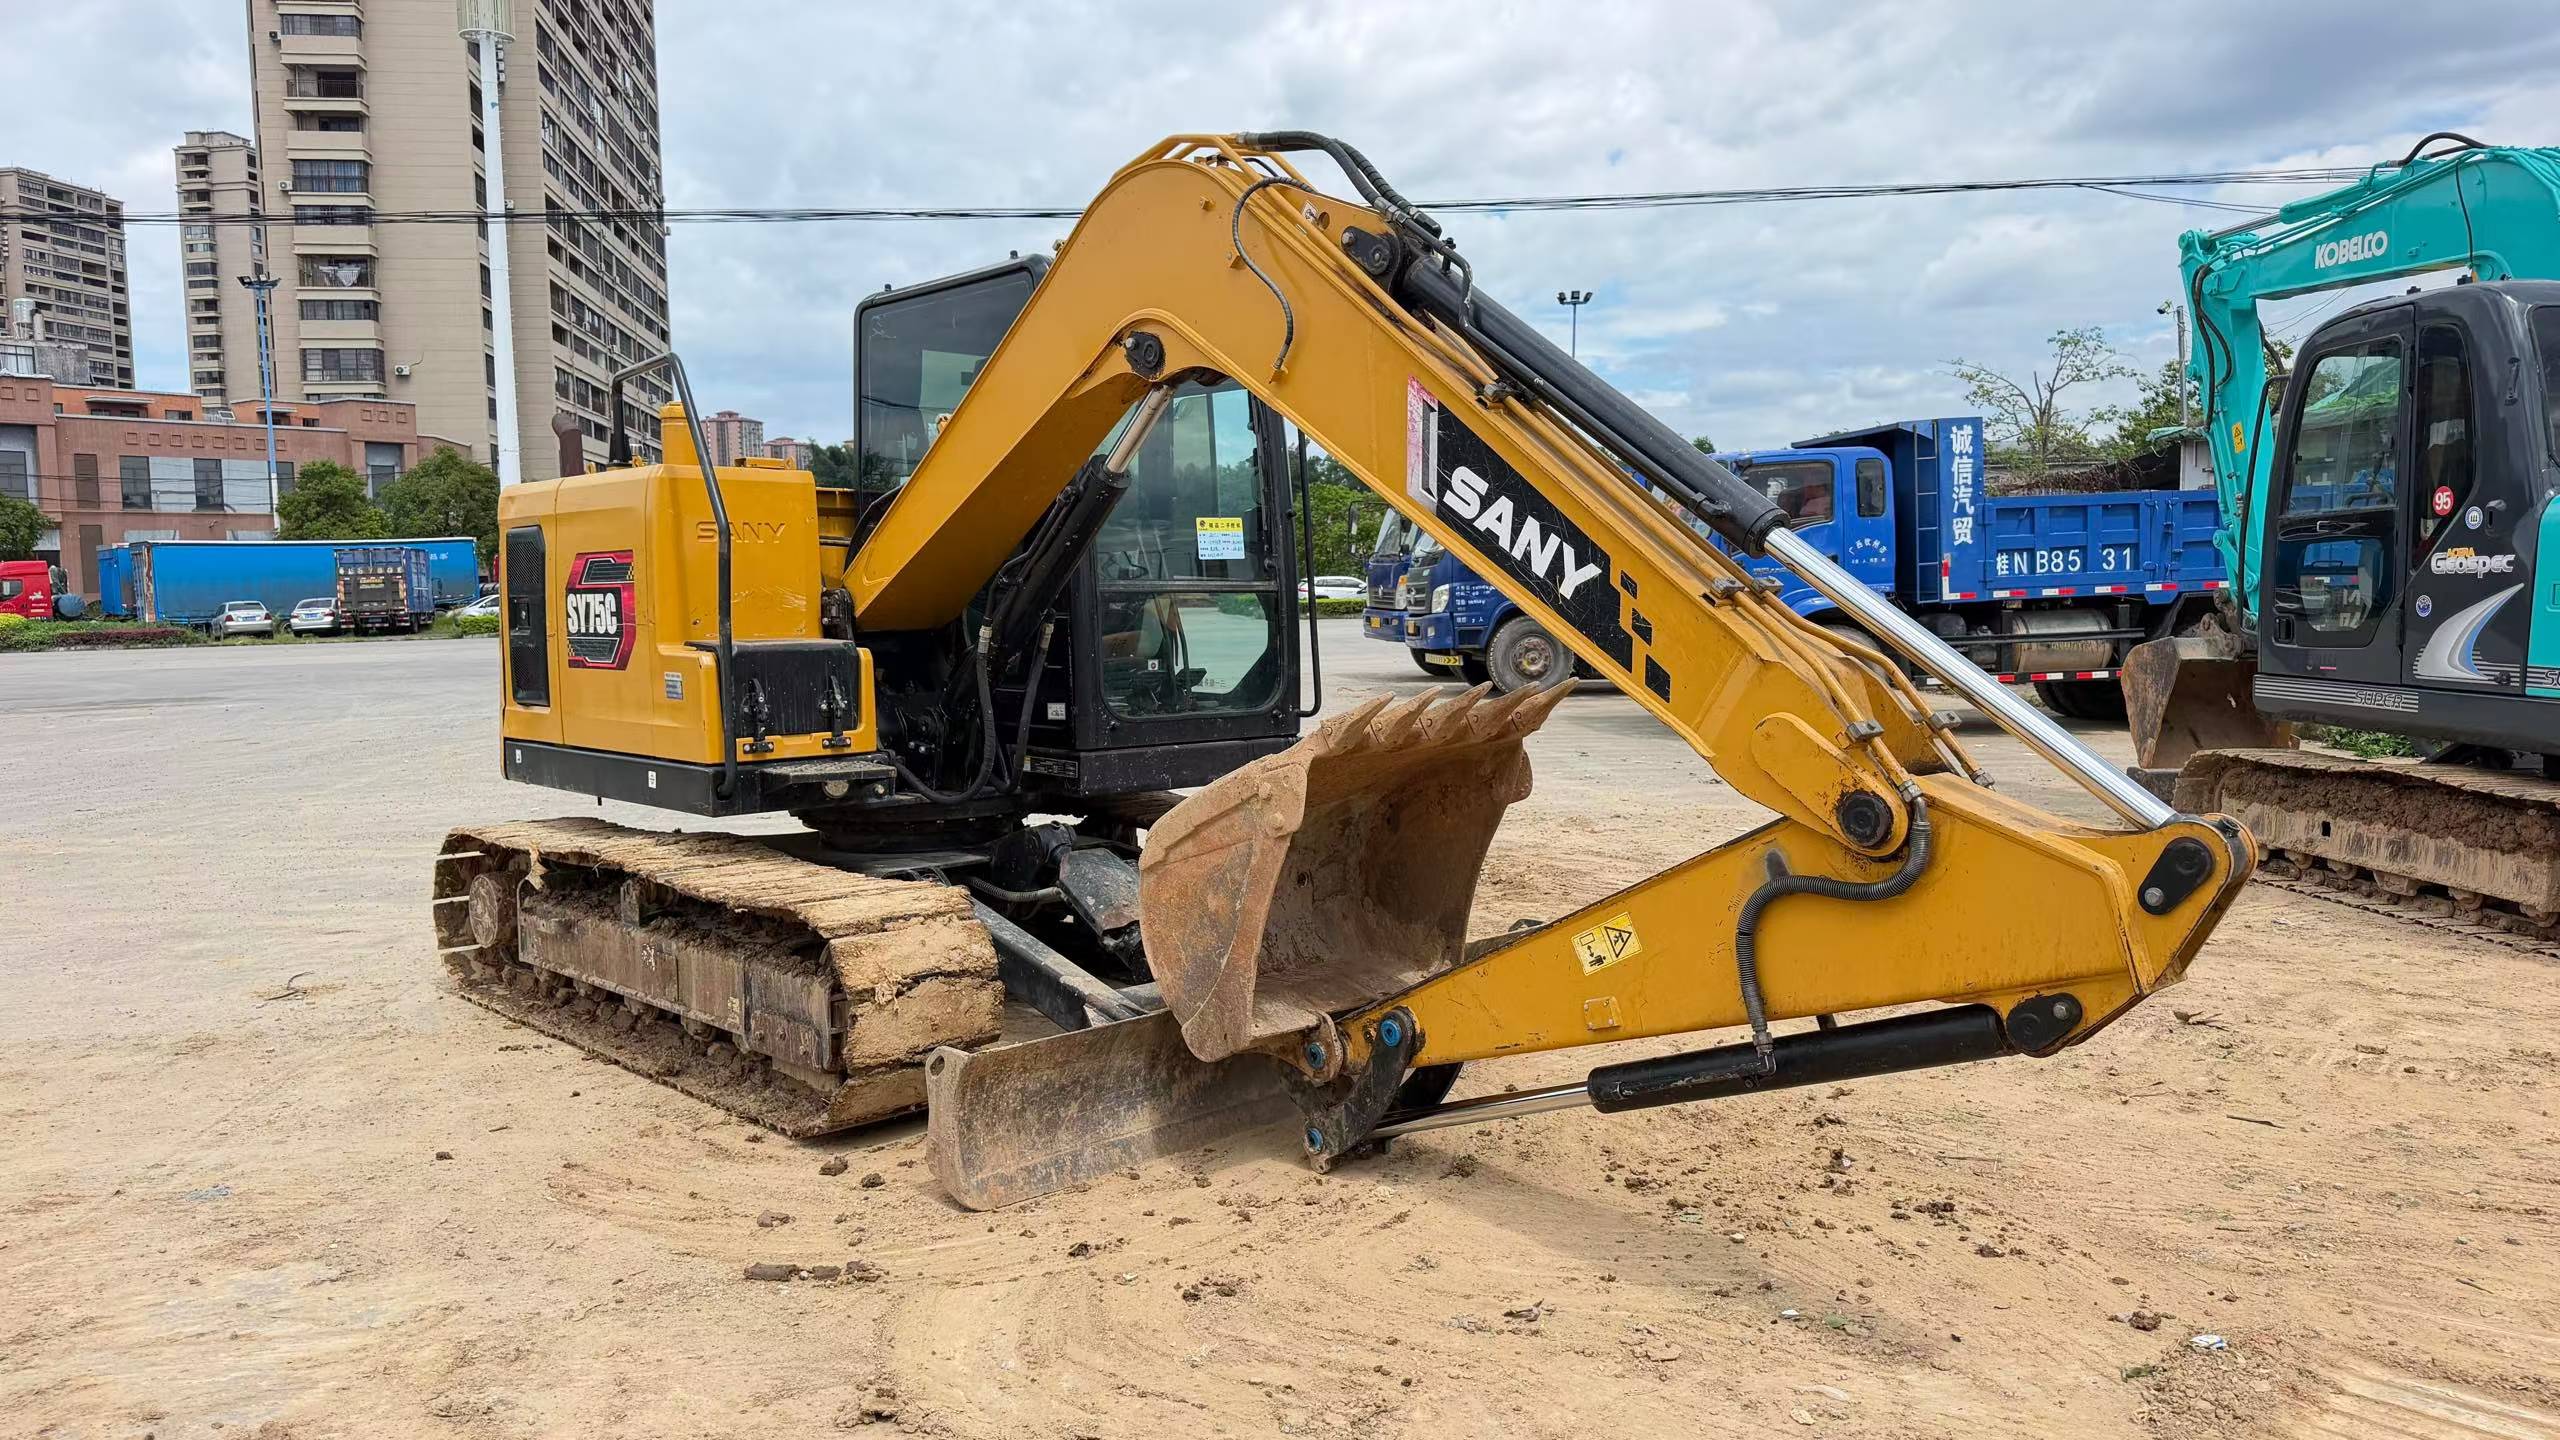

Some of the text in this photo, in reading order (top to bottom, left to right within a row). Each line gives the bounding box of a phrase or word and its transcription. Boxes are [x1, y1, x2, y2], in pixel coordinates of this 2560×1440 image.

[2314, 230, 2388, 270] KOBELCO
[1950, 424, 1975, 546] 诚信汽贸
[2435, 492, 2451, 511] 95
[1443, 466, 1602, 600] SANY
[567, 592, 617, 635] SY75C
[2355, 690, 2404, 709] SUPER
